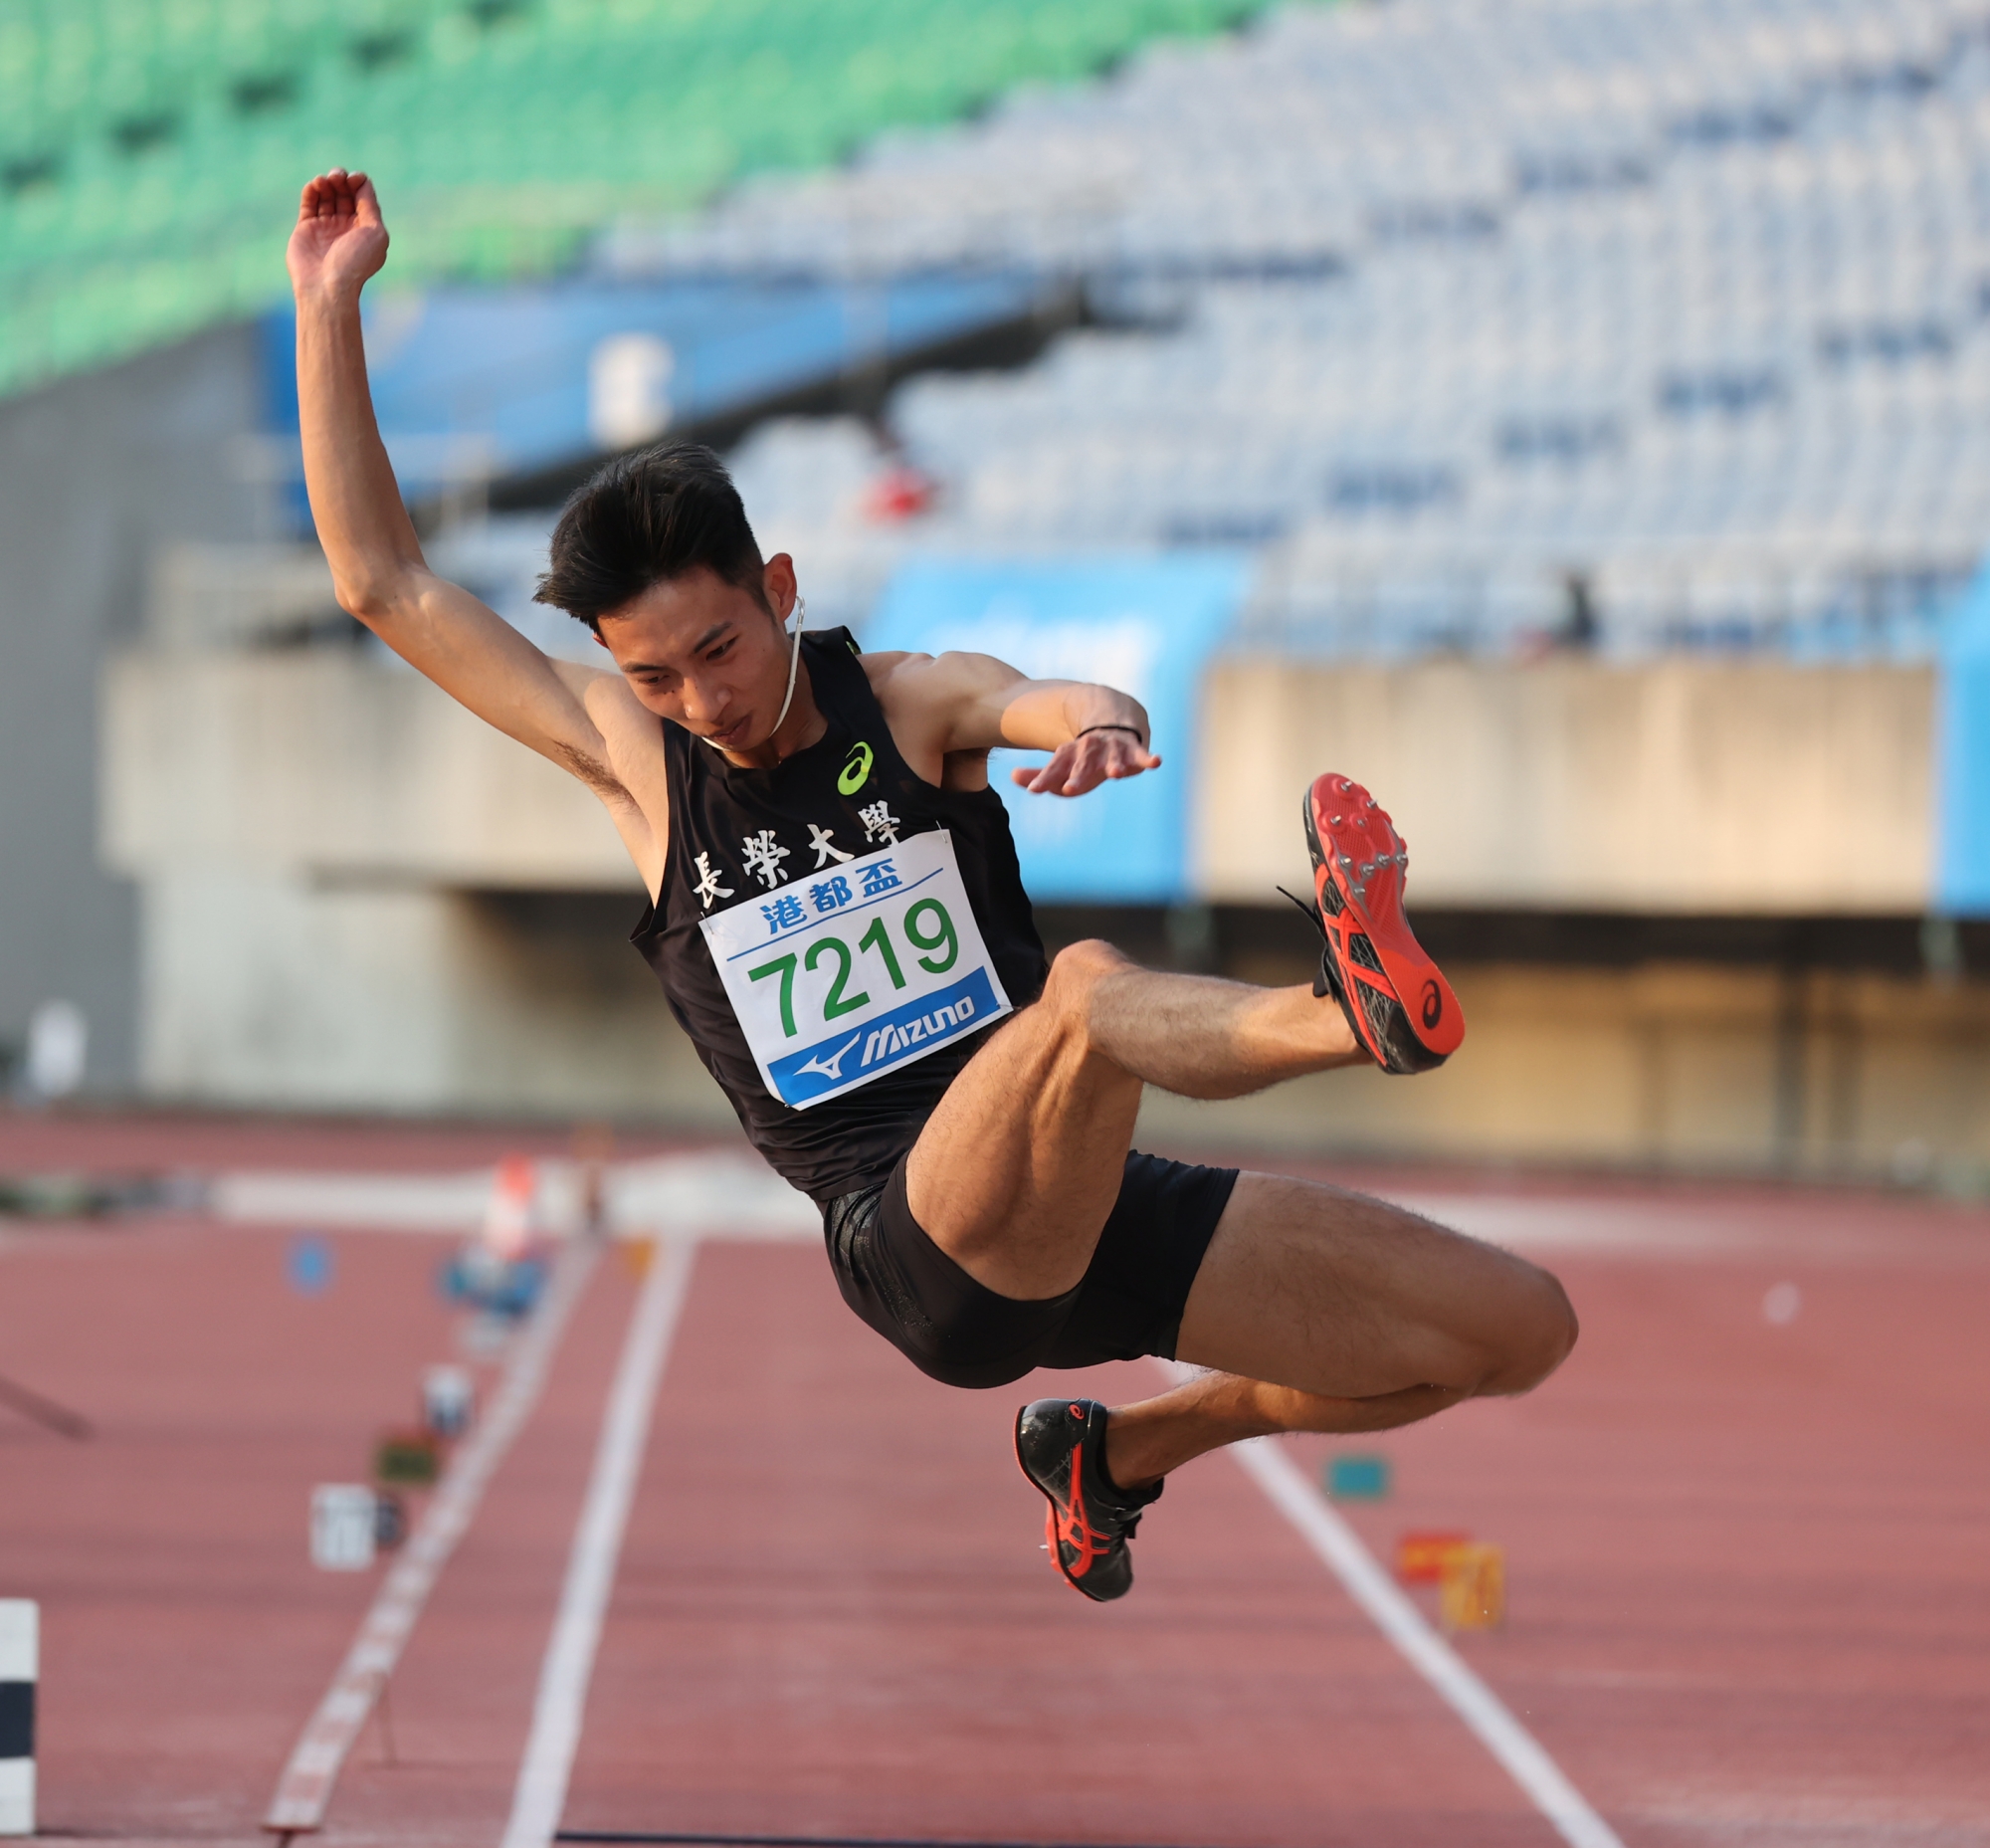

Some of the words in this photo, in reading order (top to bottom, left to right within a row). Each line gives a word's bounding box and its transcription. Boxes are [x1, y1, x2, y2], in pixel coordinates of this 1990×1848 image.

[693, 800, 900, 909] 長榮大學
[763, 858, 902, 934] 港都盃
[748, 898, 958, 1038] 7219
